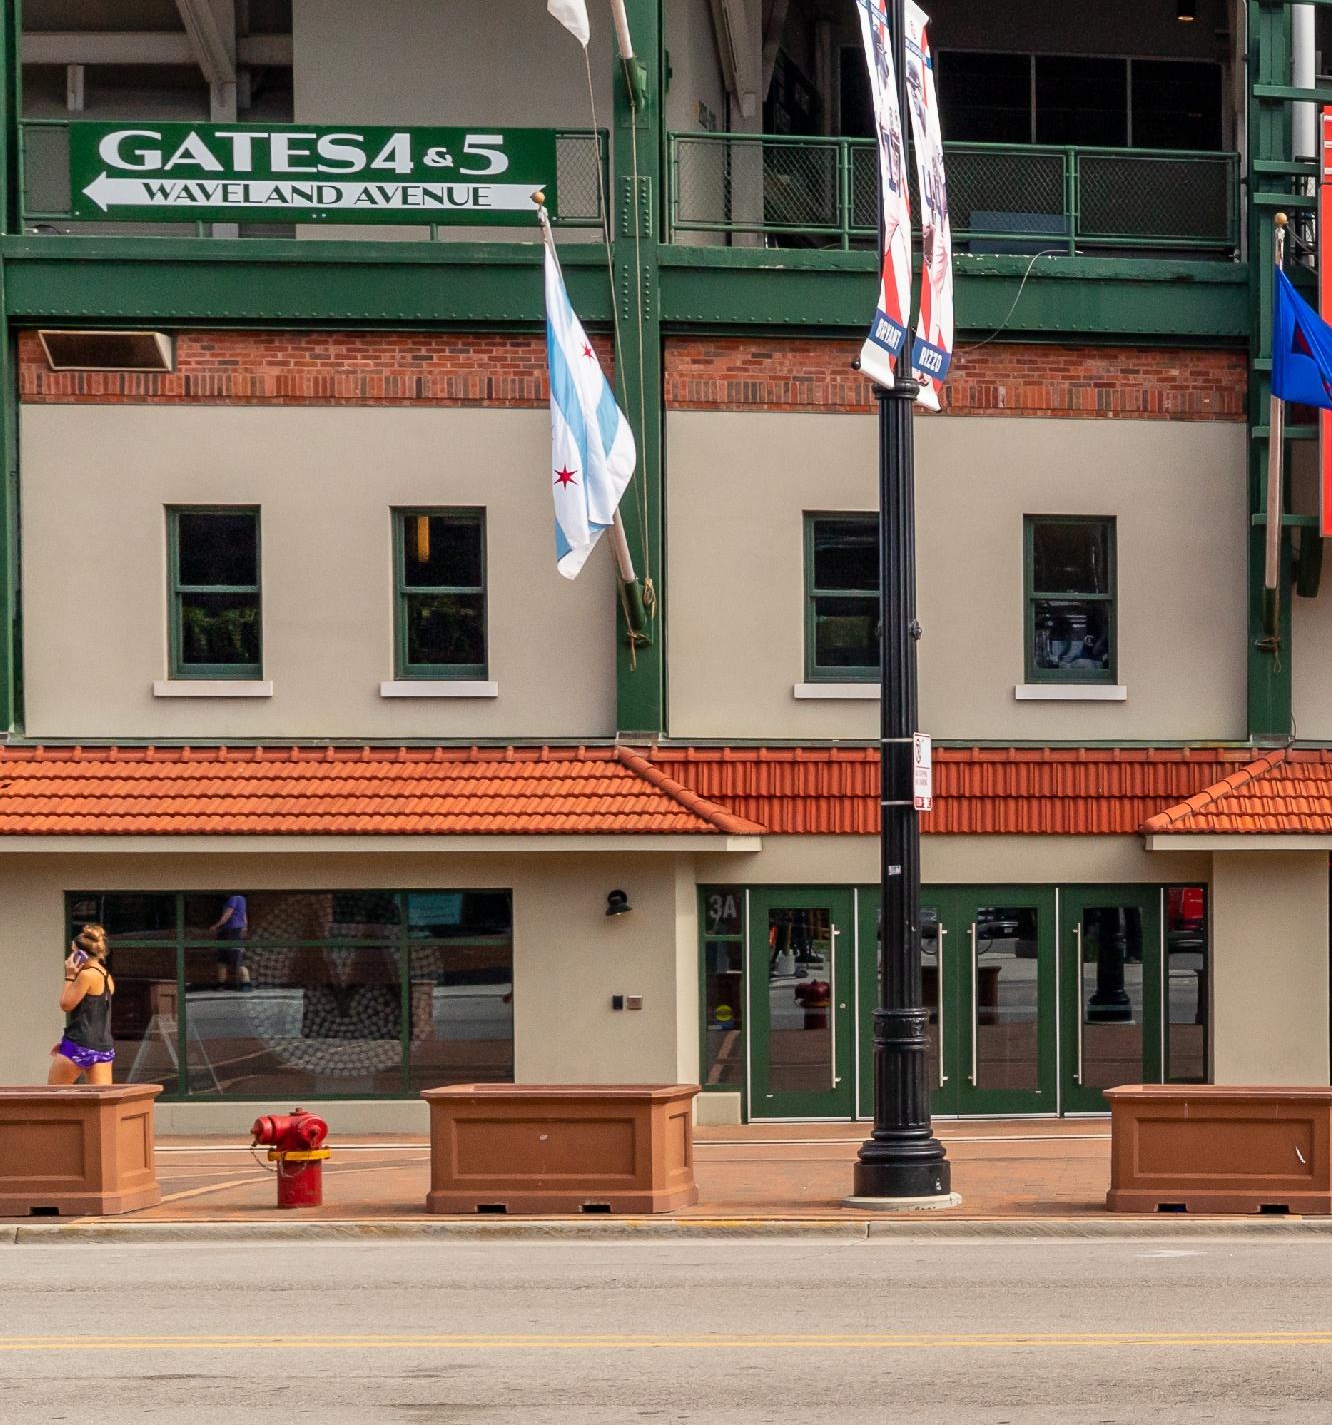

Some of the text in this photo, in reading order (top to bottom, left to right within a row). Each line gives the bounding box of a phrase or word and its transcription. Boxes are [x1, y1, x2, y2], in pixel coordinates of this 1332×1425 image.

[142, 181, 491, 207] WAVELAND AVENUE
[919, 346, 943, 373] RIZZO
[710, 895, 737, 918] 3A
